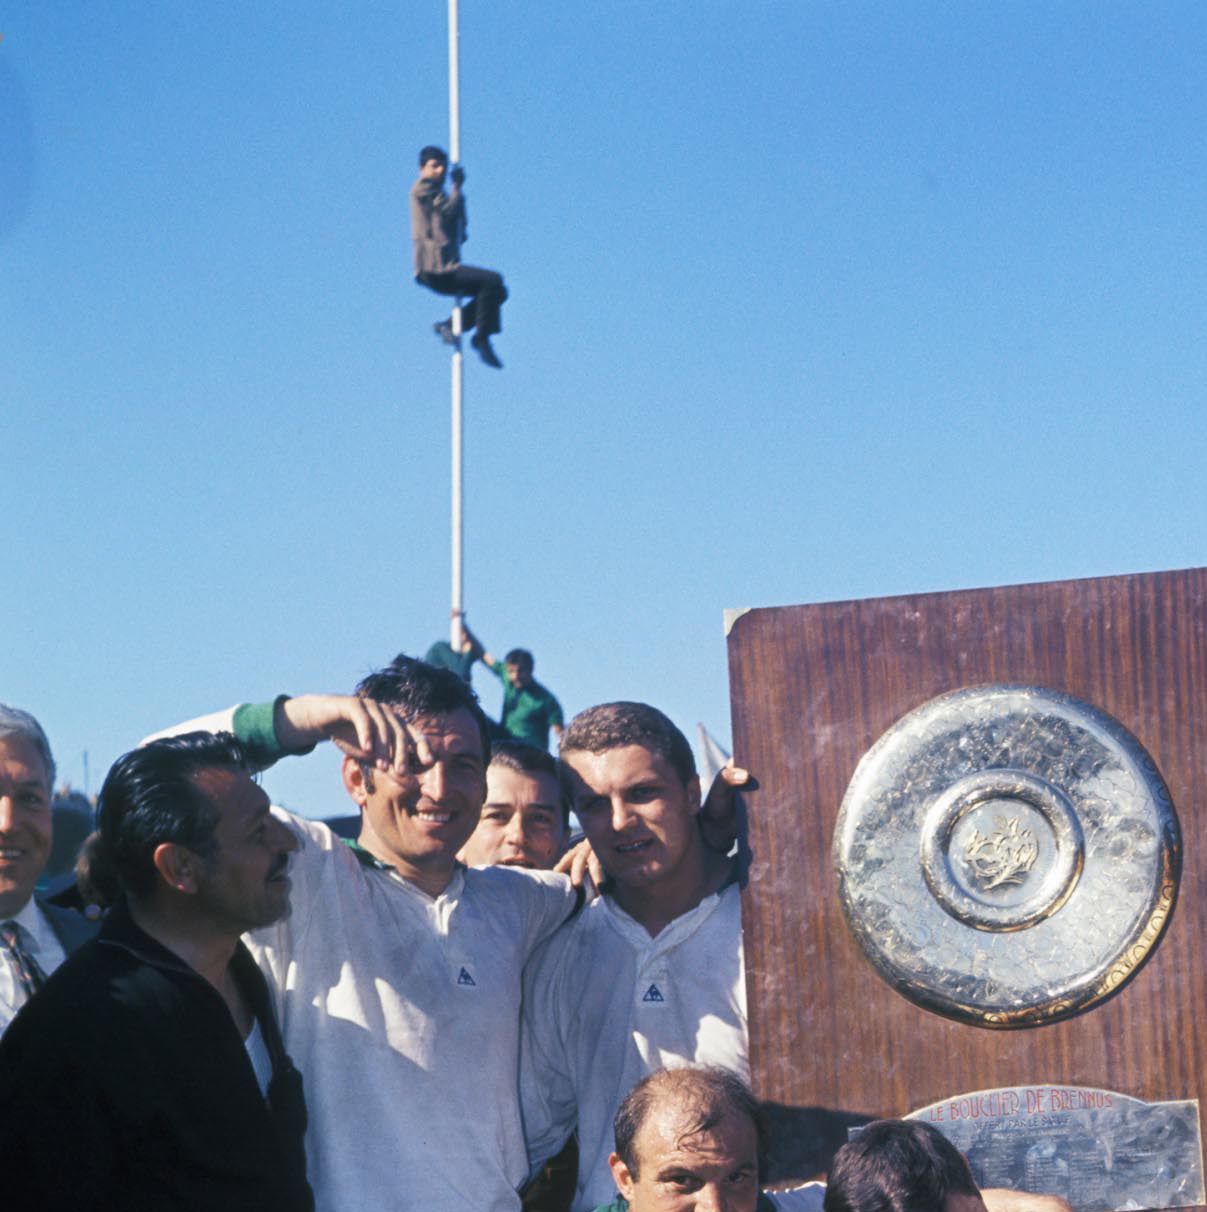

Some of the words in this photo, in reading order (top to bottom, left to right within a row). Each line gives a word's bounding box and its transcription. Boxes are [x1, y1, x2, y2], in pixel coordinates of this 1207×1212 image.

[930, 1107, 944, 1121] LE
[951, 1091, 1019, 1120] BOUCLIER
[1026, 1089, 1045, 1114] DE
[1052, 1089, 1112, 1112] BRENNUS
